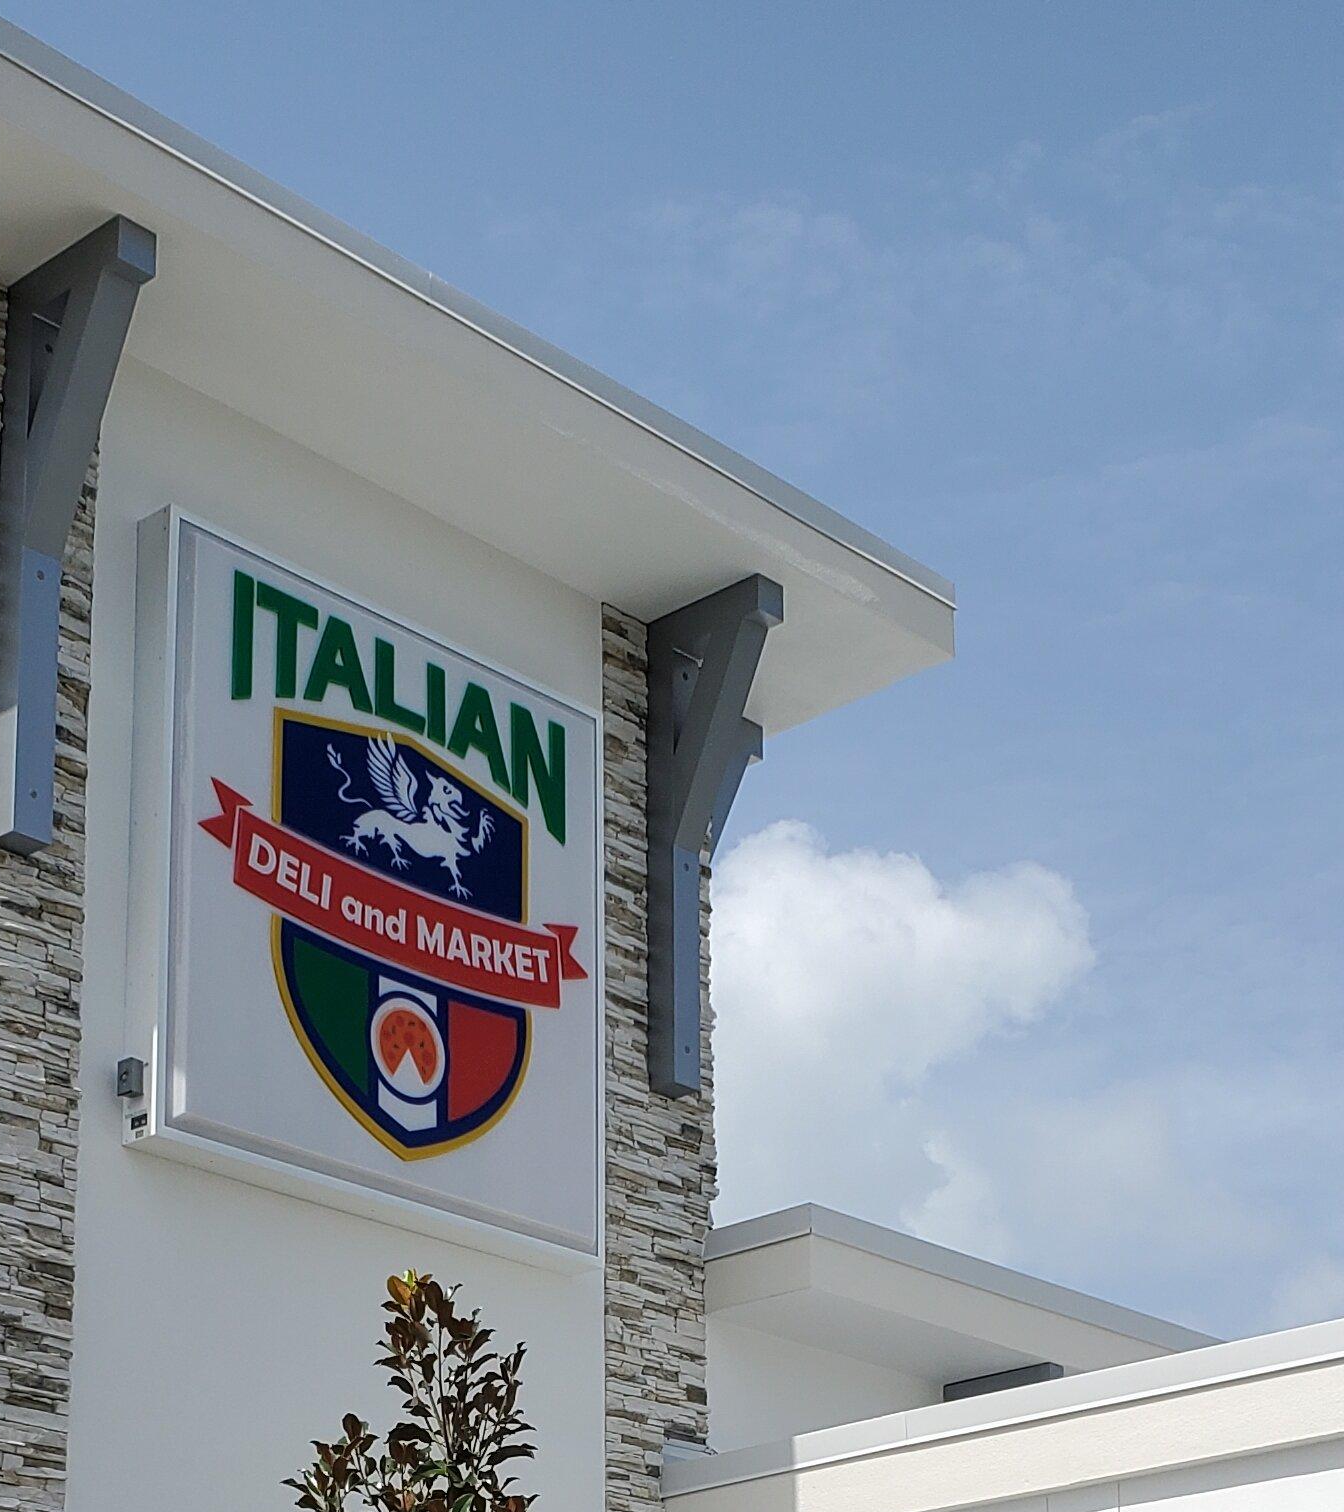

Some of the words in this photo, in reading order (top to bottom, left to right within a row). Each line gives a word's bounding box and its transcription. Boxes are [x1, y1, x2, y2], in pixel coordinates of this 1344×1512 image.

[231, 569, 566, 846] ITALIAN
[248, 833, 332, 911] DELI
[341, 895, 407, 945] and
[416, 914, 550, 983] MARKET
